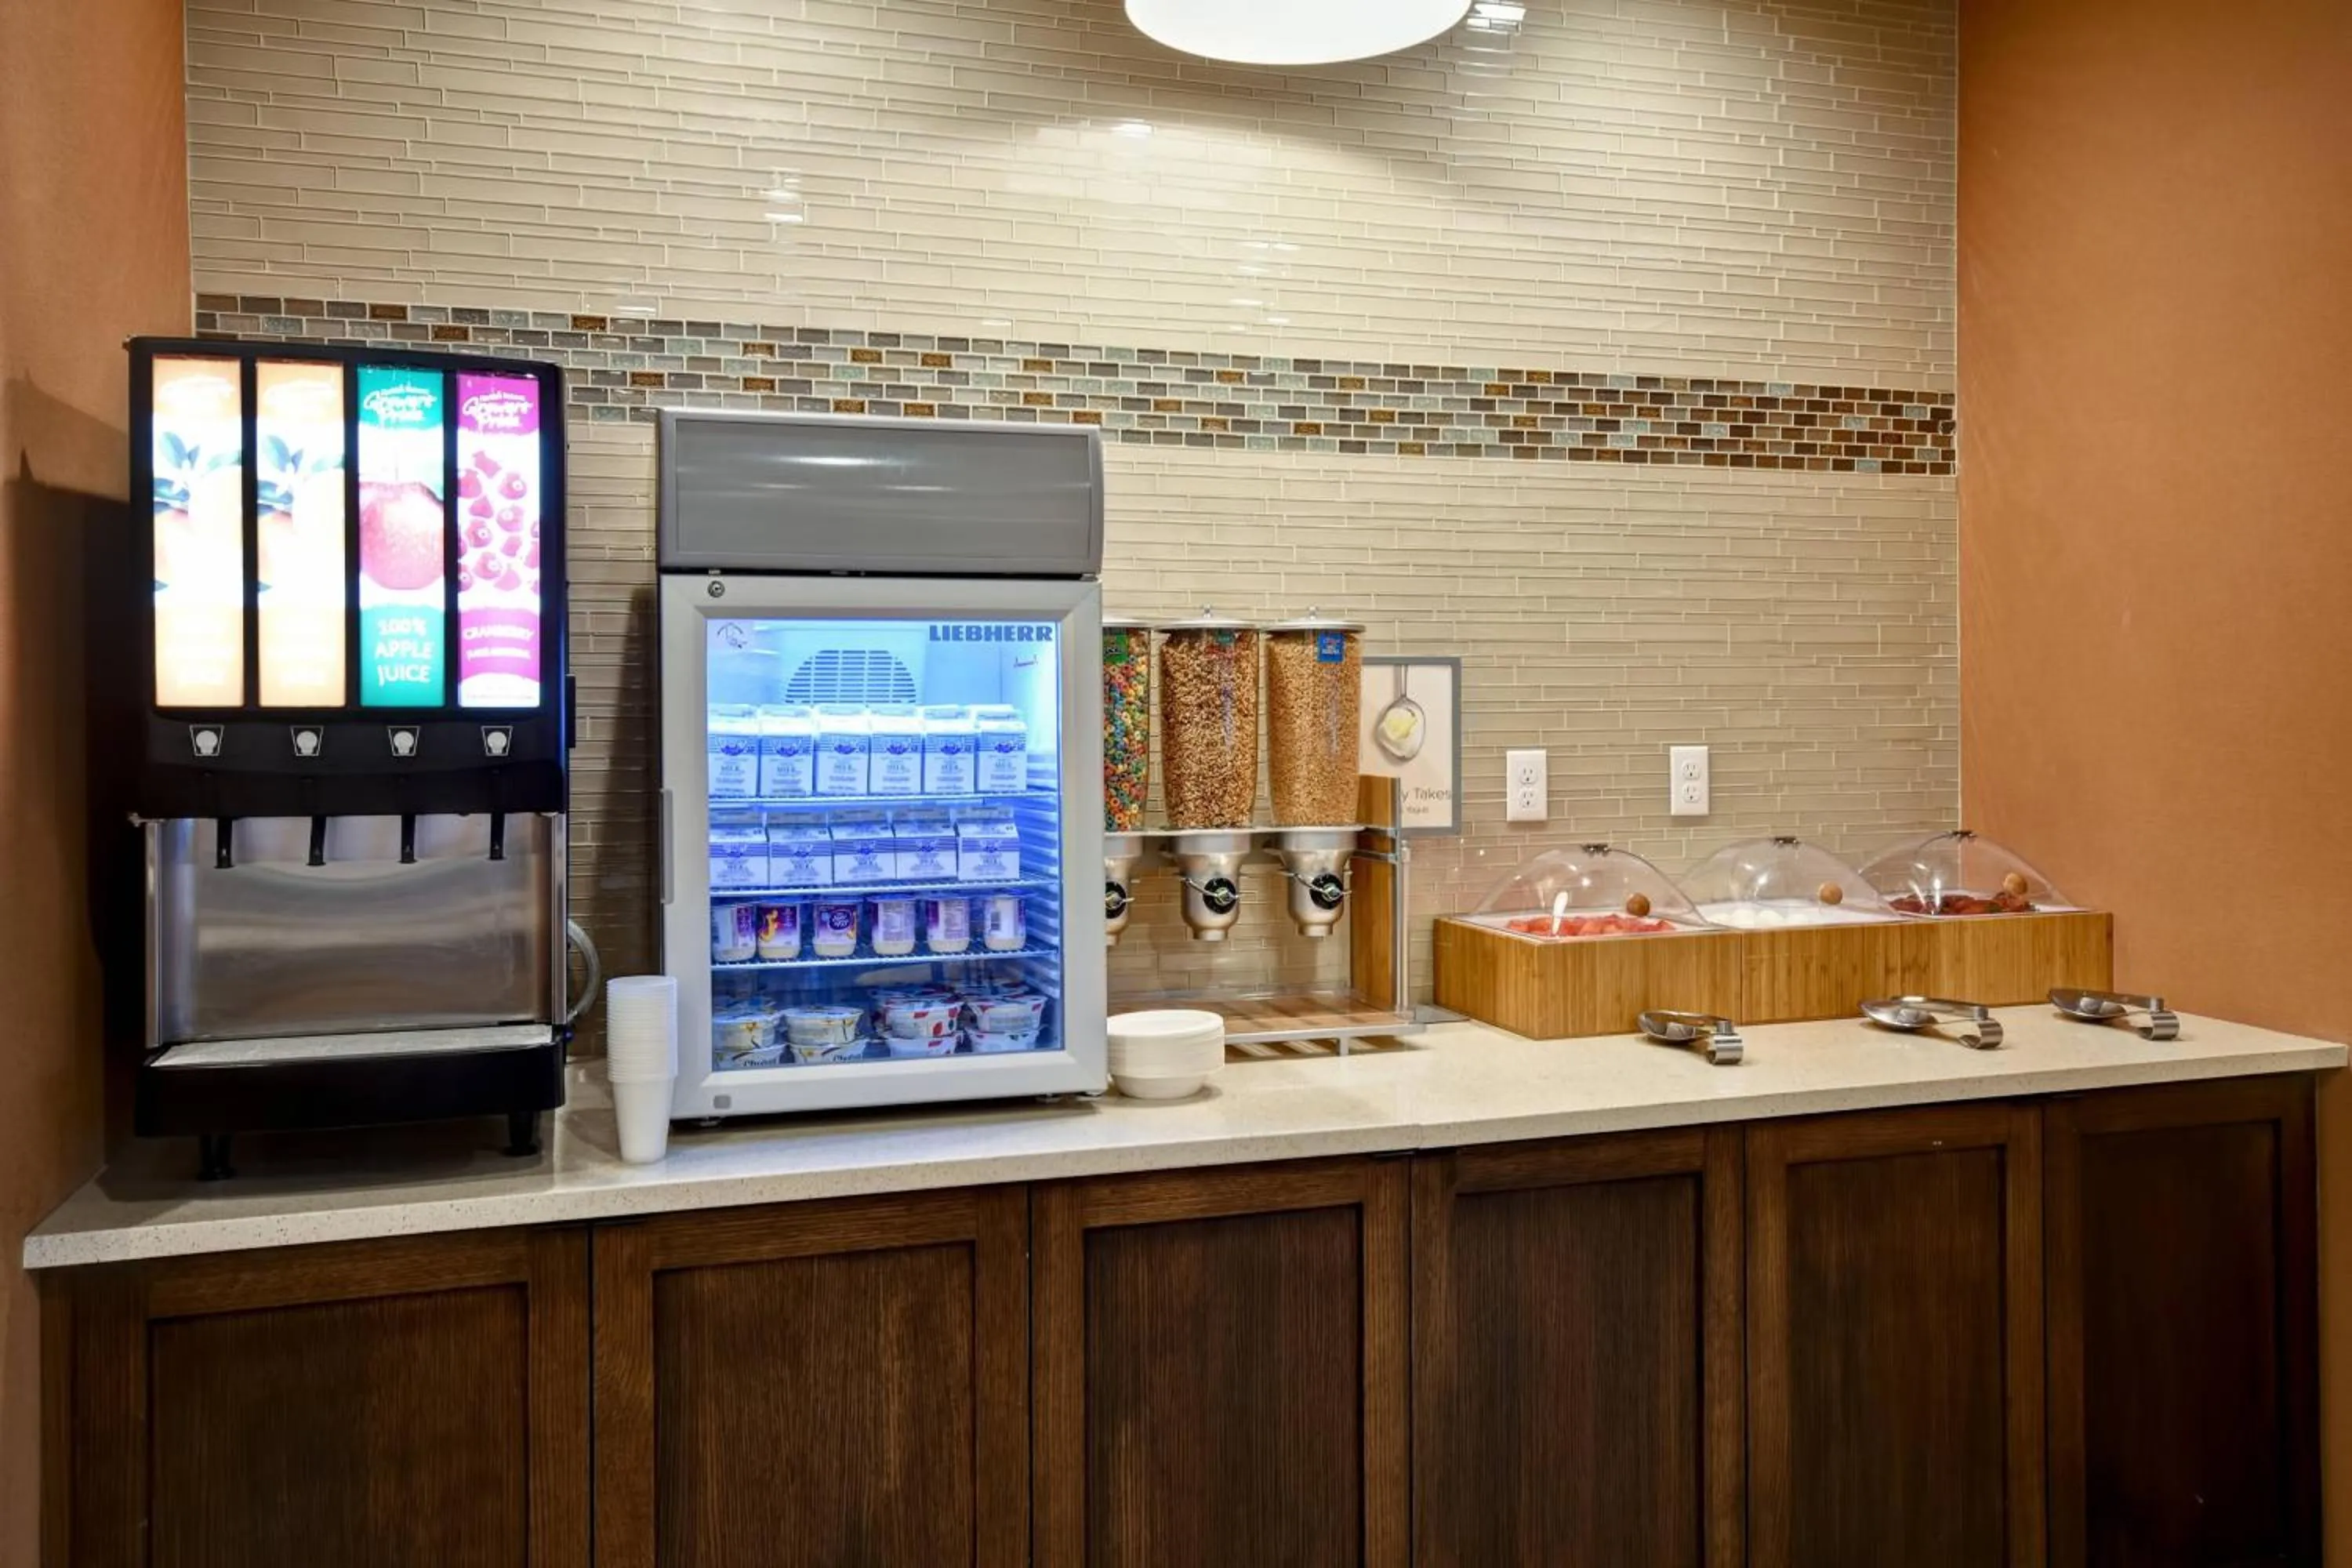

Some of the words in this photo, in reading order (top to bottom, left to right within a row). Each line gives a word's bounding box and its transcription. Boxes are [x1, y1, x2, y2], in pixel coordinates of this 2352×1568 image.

[929, 625, 1053, 642] LIEBHERR
[375, 640, 434, 659] APPLE
[377, 665, 430, 687] JUICE
[1413, 787, 1452, 800] Takes
